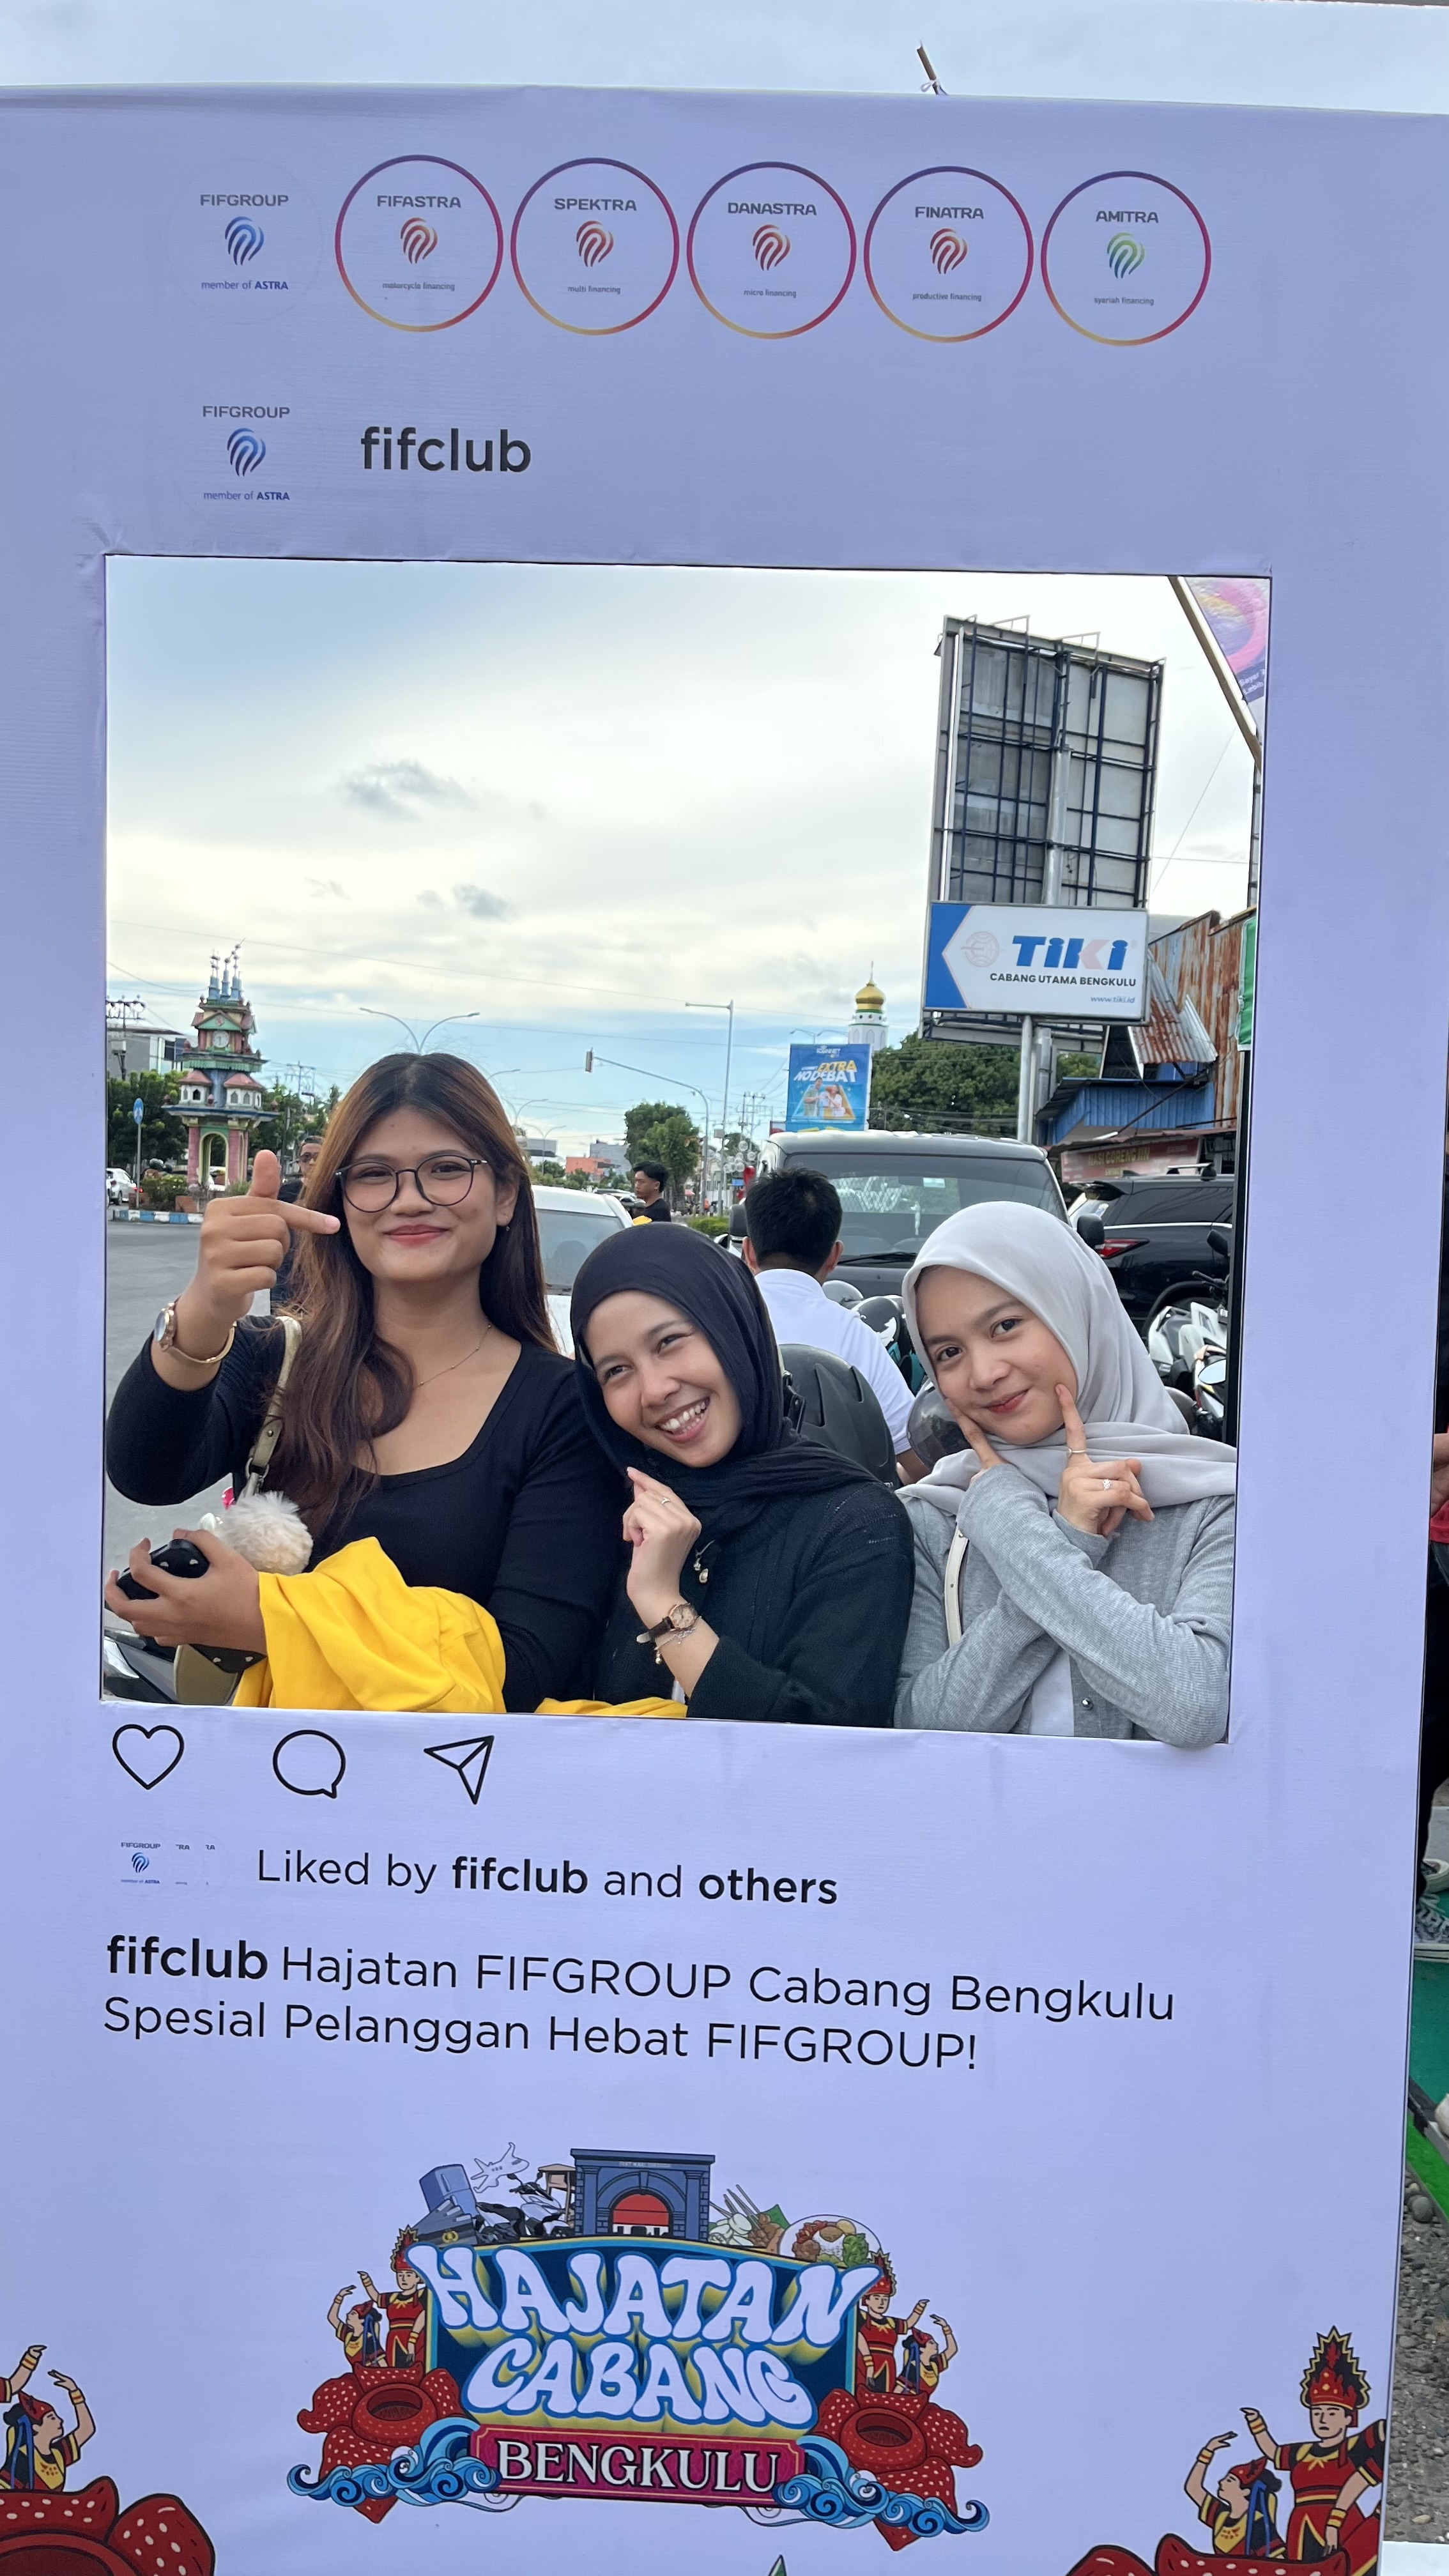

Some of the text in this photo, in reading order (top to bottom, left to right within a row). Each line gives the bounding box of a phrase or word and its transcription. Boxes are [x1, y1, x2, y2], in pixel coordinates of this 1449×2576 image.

[200, 194, 289, 206] FIFGROUP
[377, 195, 461, 208] FIFASTRA
[554, 198, 637, 211] SPEKTRA
[728, 202, 817, 216] DANASTRA
[915, 206, 985, 219] FINATRA
[1095, 210, 1159, 224] AMITRA
[201, 280, 289, 290] member of ASTRA
[382, 282, 456, 292] motorcycle financing
[588, 285, 621, 295] financing
[743, 288, 797, 299] micro financing
[912, 292, 982, 302] productive financing
[1094, 296, 1154, 307] syariah financing
[203, 405, 291, 418] FIFGROUP
[360, 426, 531, 473] fifclub
[203, 490, 290, 500] member of ASTRA
[990, 972, 1136, 987] CABANG UTAMA BENGKULU
[817, 1060, 857, 1072] EXTRA
[259, 1849, 837, 1905] Liked by fifclub and others
[107, 1935, 1173, 2023] fifclub Hajatan FIFGROUP Cabang Bengkulu
[104, 1997, 976, 2069] Spesial Pelanggan Hebat FIFGROUP!
[404, 2243, 882, 2348] HAJATAN
[466, 2337, 816, 2425] CABANG
[496, 2439, 779, 2492] BENGKULU
